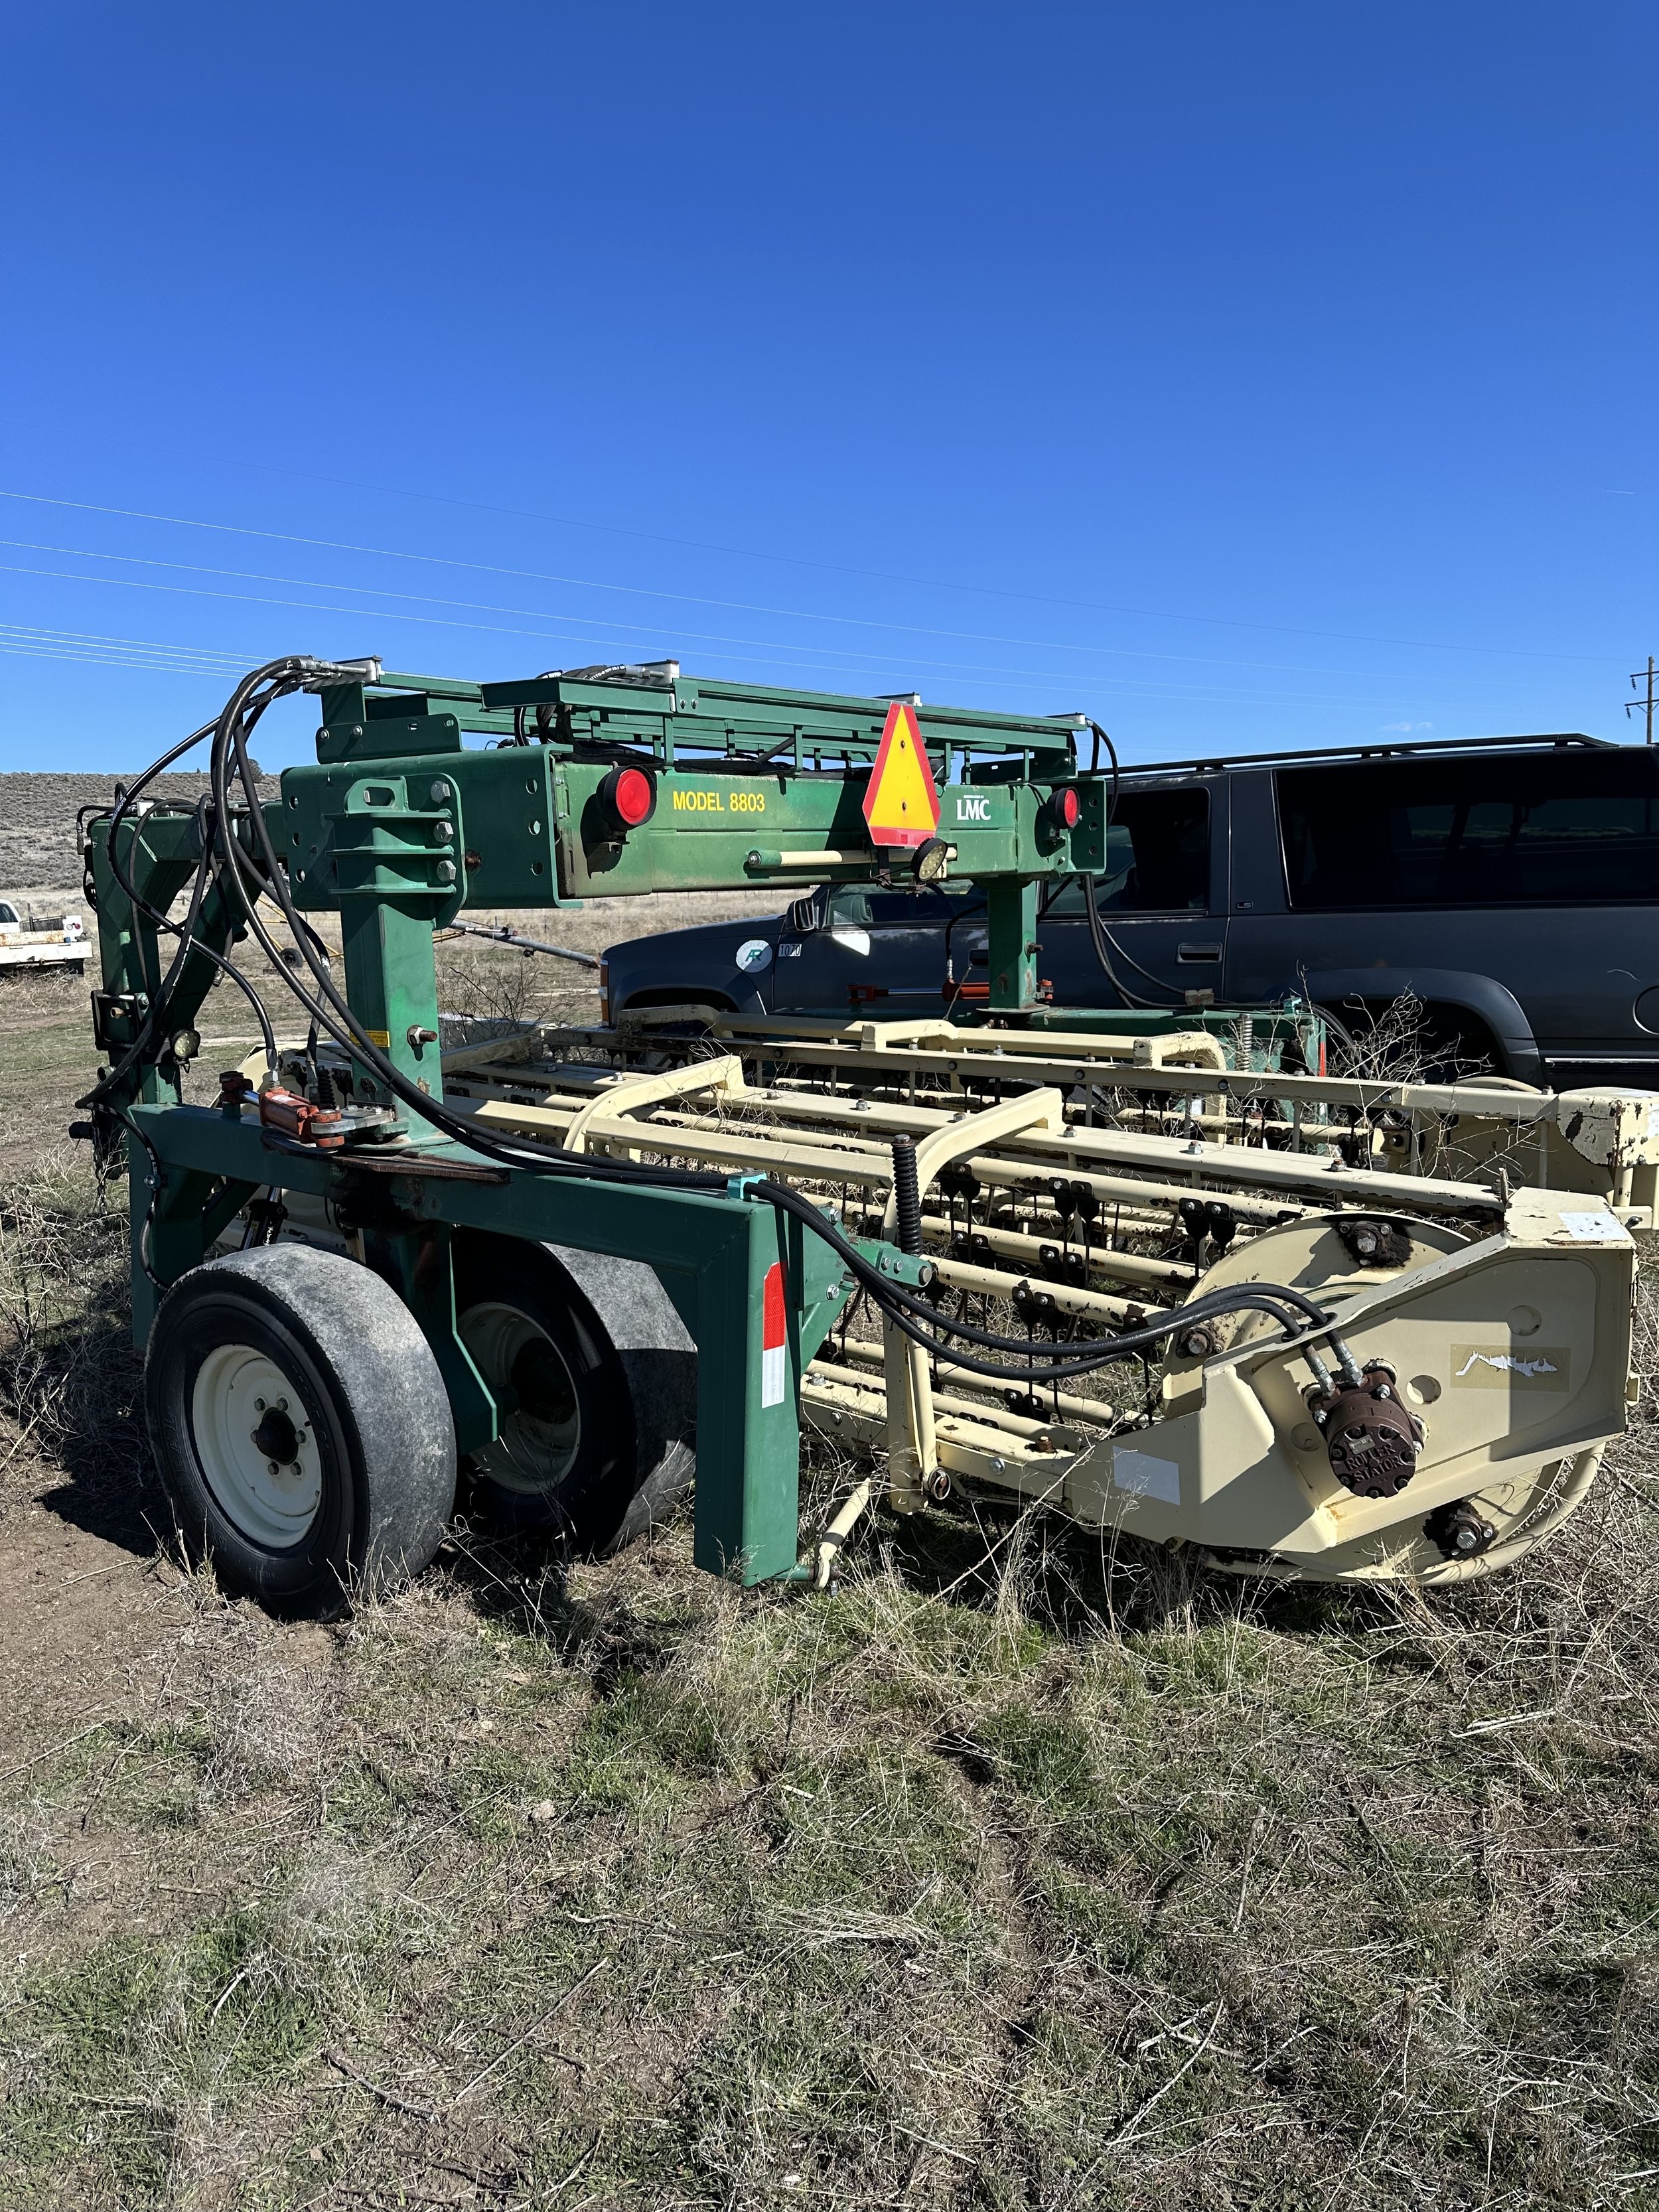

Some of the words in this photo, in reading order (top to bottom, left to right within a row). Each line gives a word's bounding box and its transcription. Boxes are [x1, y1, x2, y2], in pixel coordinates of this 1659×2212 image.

[673, 790, 725, 811] MODEL
[729, 792, 765, 812] 8803
[956, 799, 991, 821] LMC
[780, 944, 800, 956] 1070
[1344, 1443, 1396, 1471] ROLLER
[1354, 1456, 1404, 1483] STATOR
